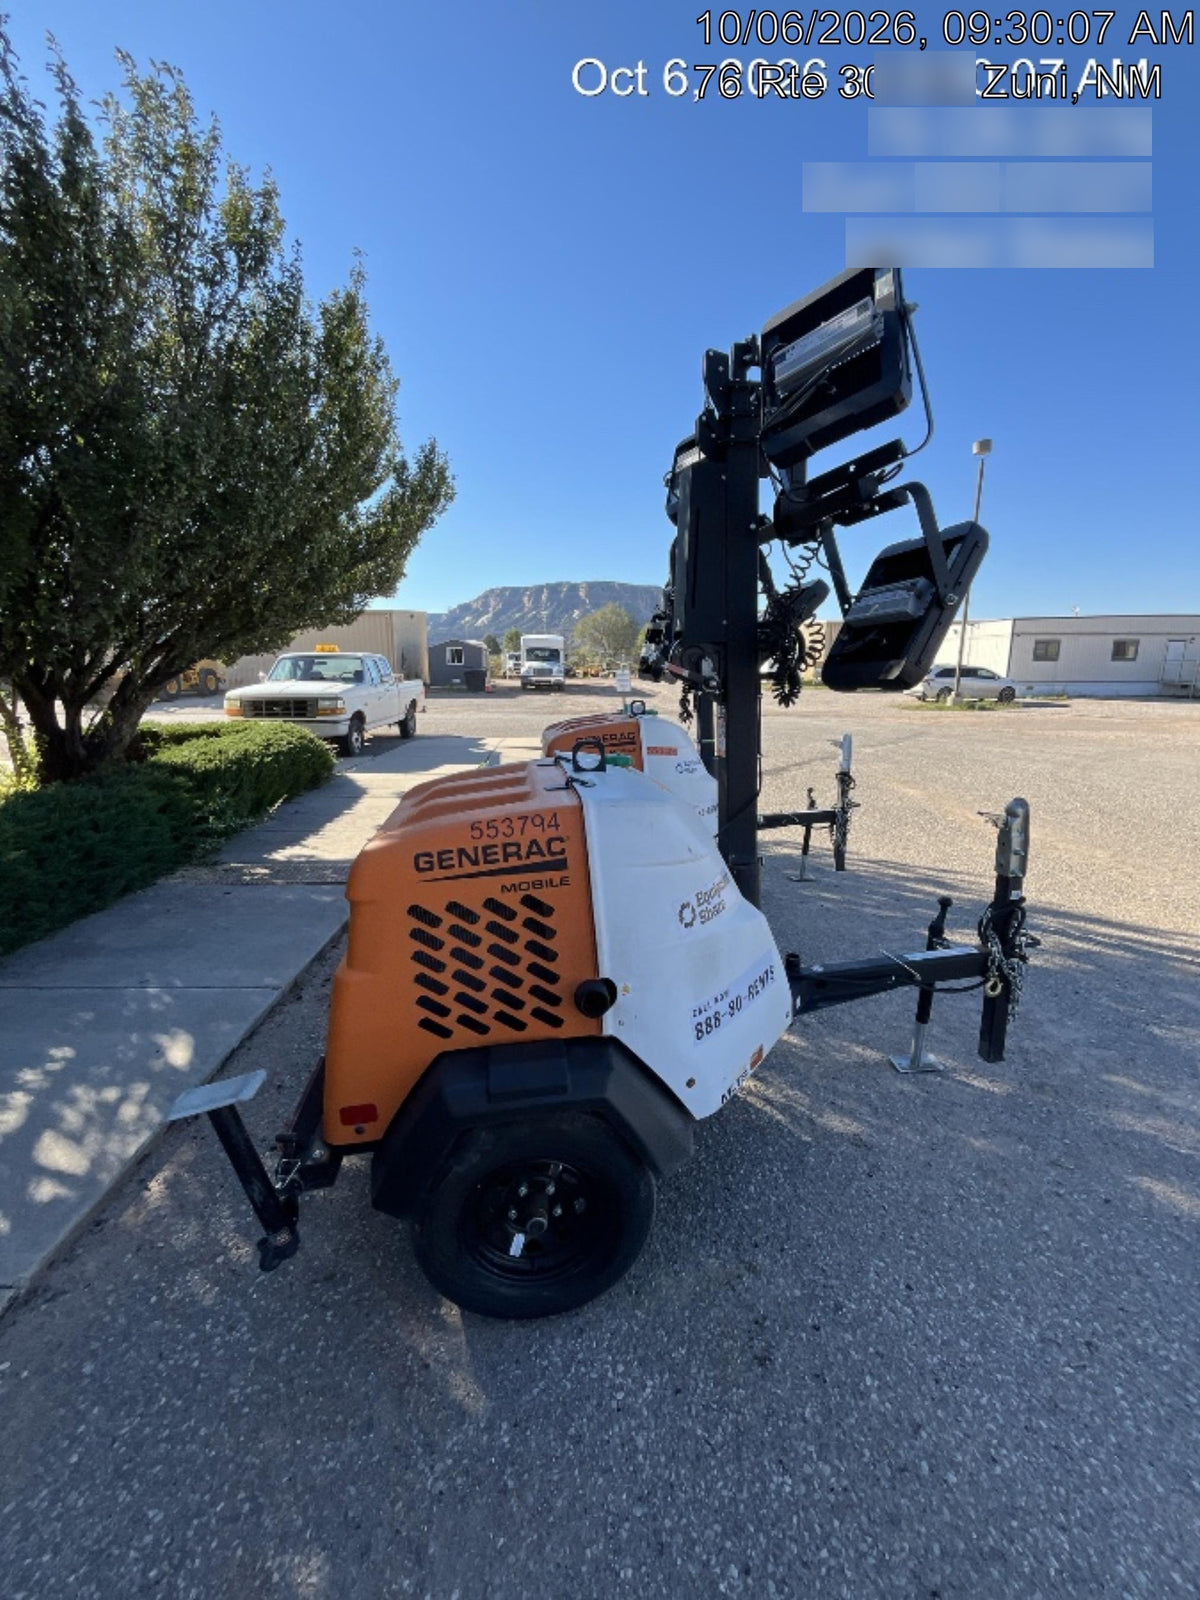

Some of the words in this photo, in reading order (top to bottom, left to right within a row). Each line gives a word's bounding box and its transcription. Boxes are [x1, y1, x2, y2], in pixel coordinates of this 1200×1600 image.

[470, 812, 561, 840] 553794
[413, 836, 568, 873] GENERAC
[501, 876, 571, 893] MOBILE
